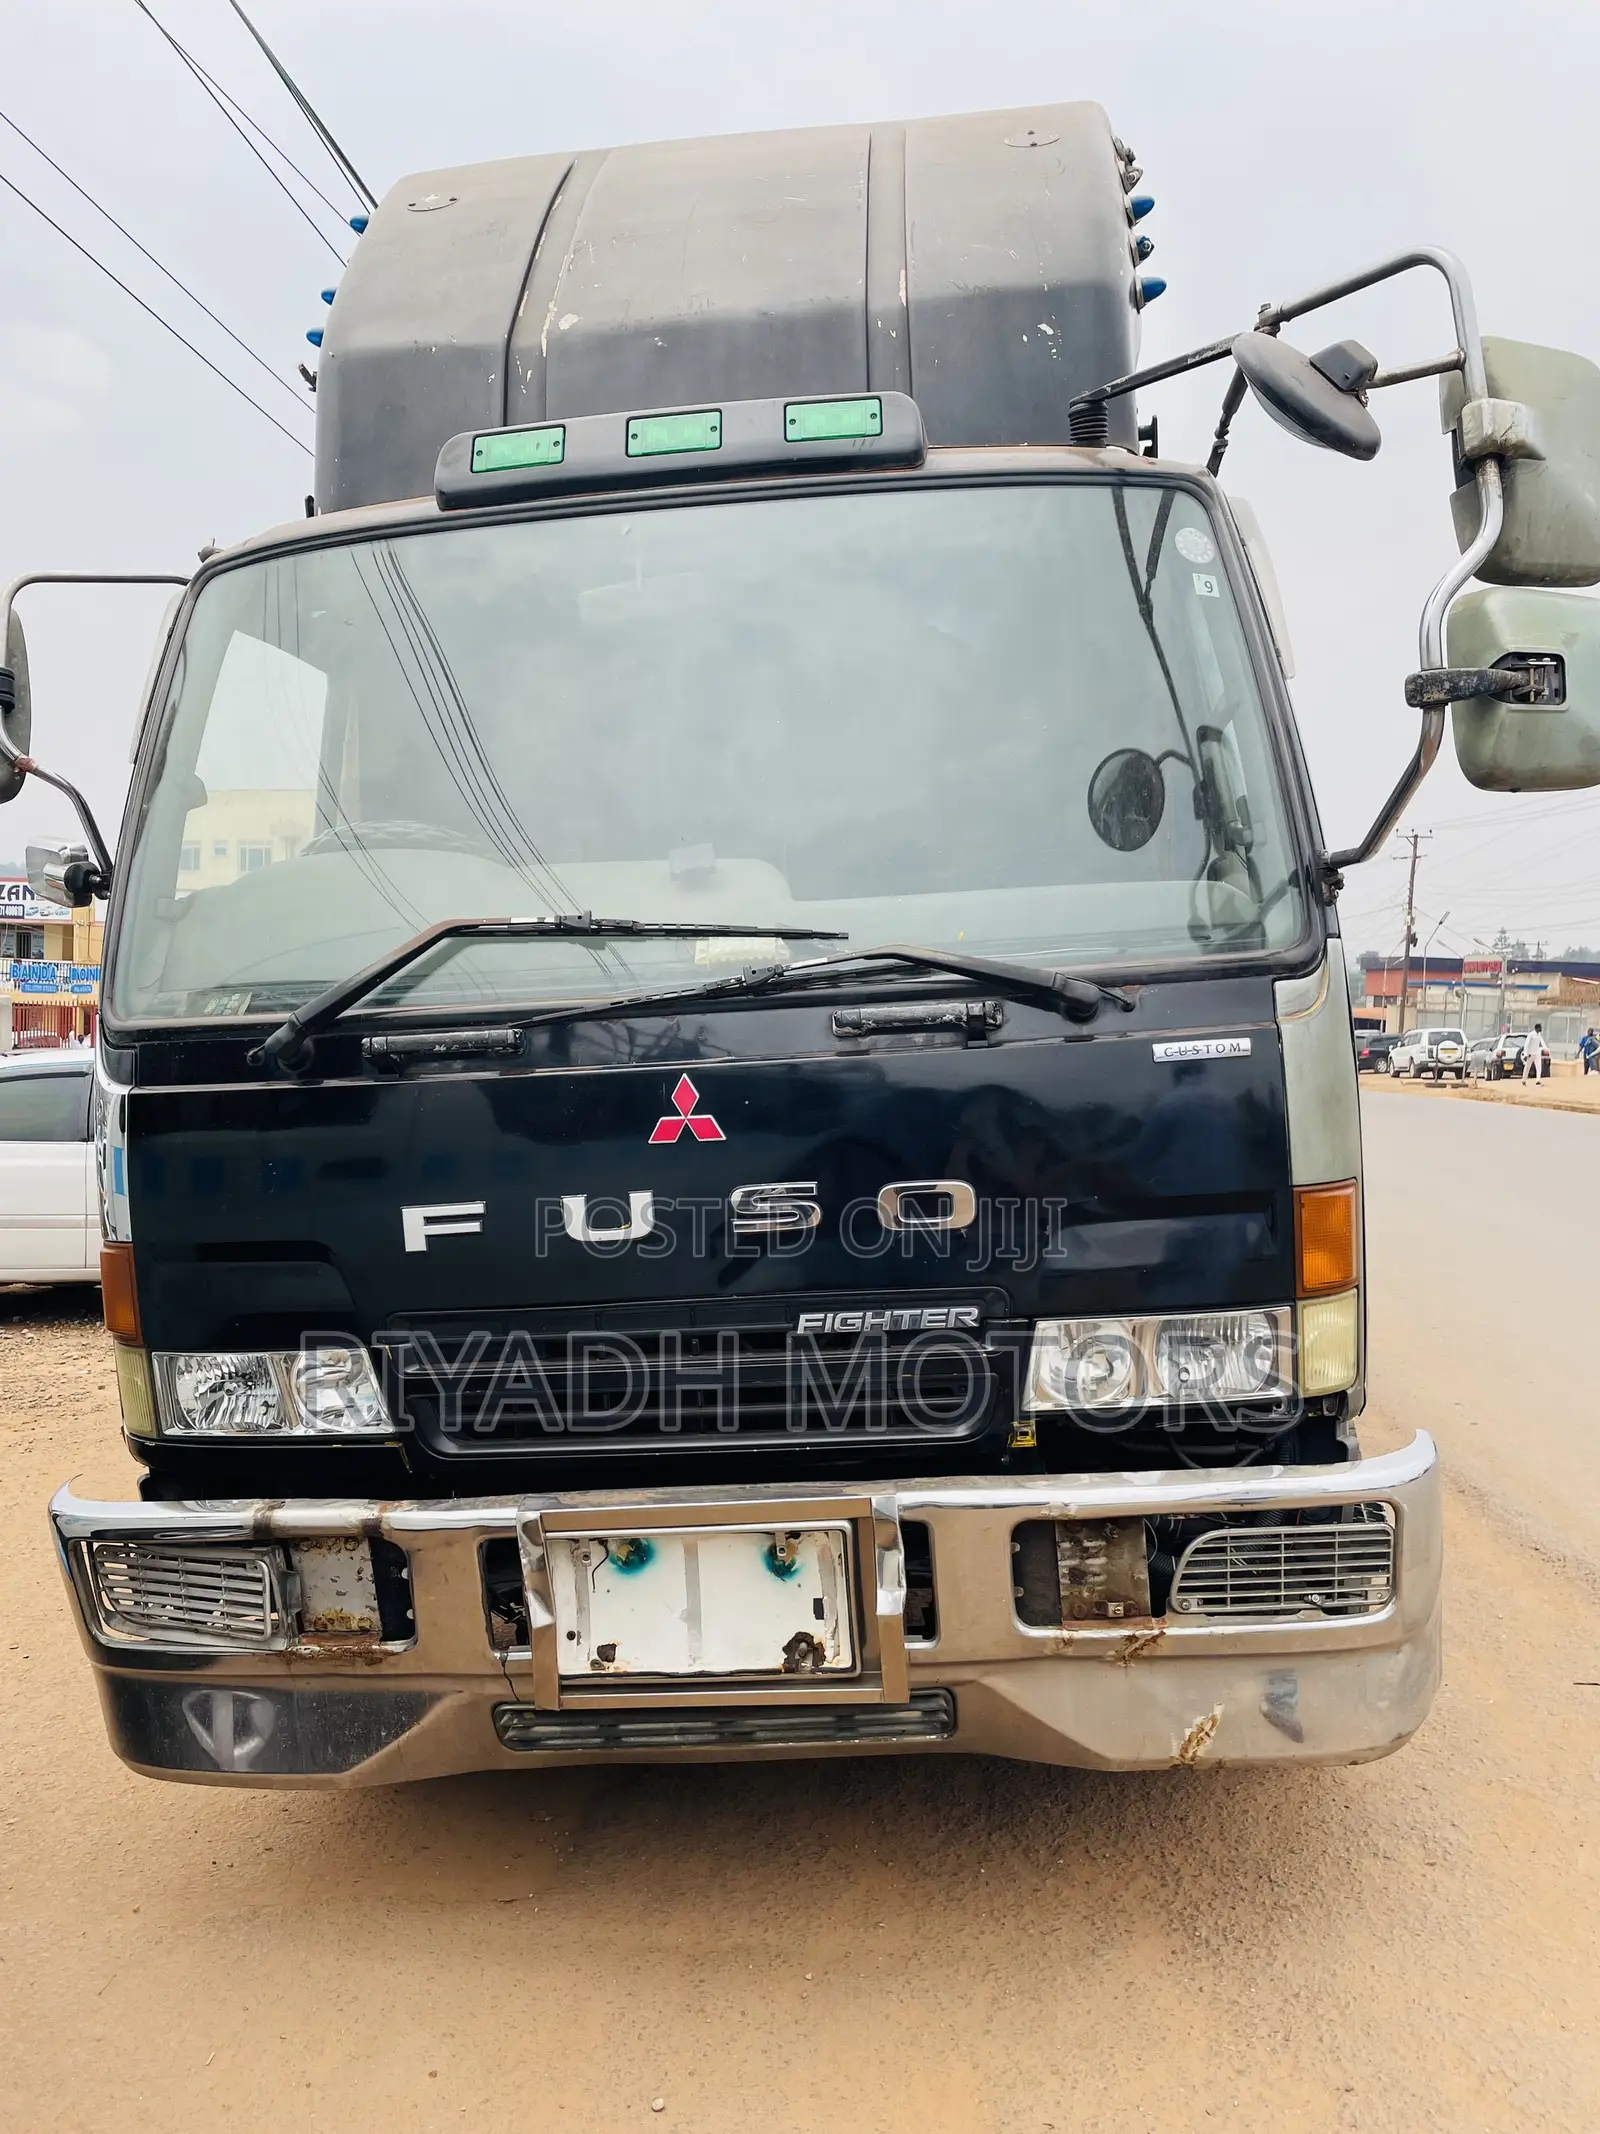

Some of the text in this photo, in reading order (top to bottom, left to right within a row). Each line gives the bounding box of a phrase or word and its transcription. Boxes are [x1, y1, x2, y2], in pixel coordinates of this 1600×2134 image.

[12, 963, 99, 981] BANDA BON
[1164, 1042, 1242, 1058] CUSTOM
[401, 1180, 977, 1253] FUSO
[797, 1306, 980, 1335] FIGHTER
